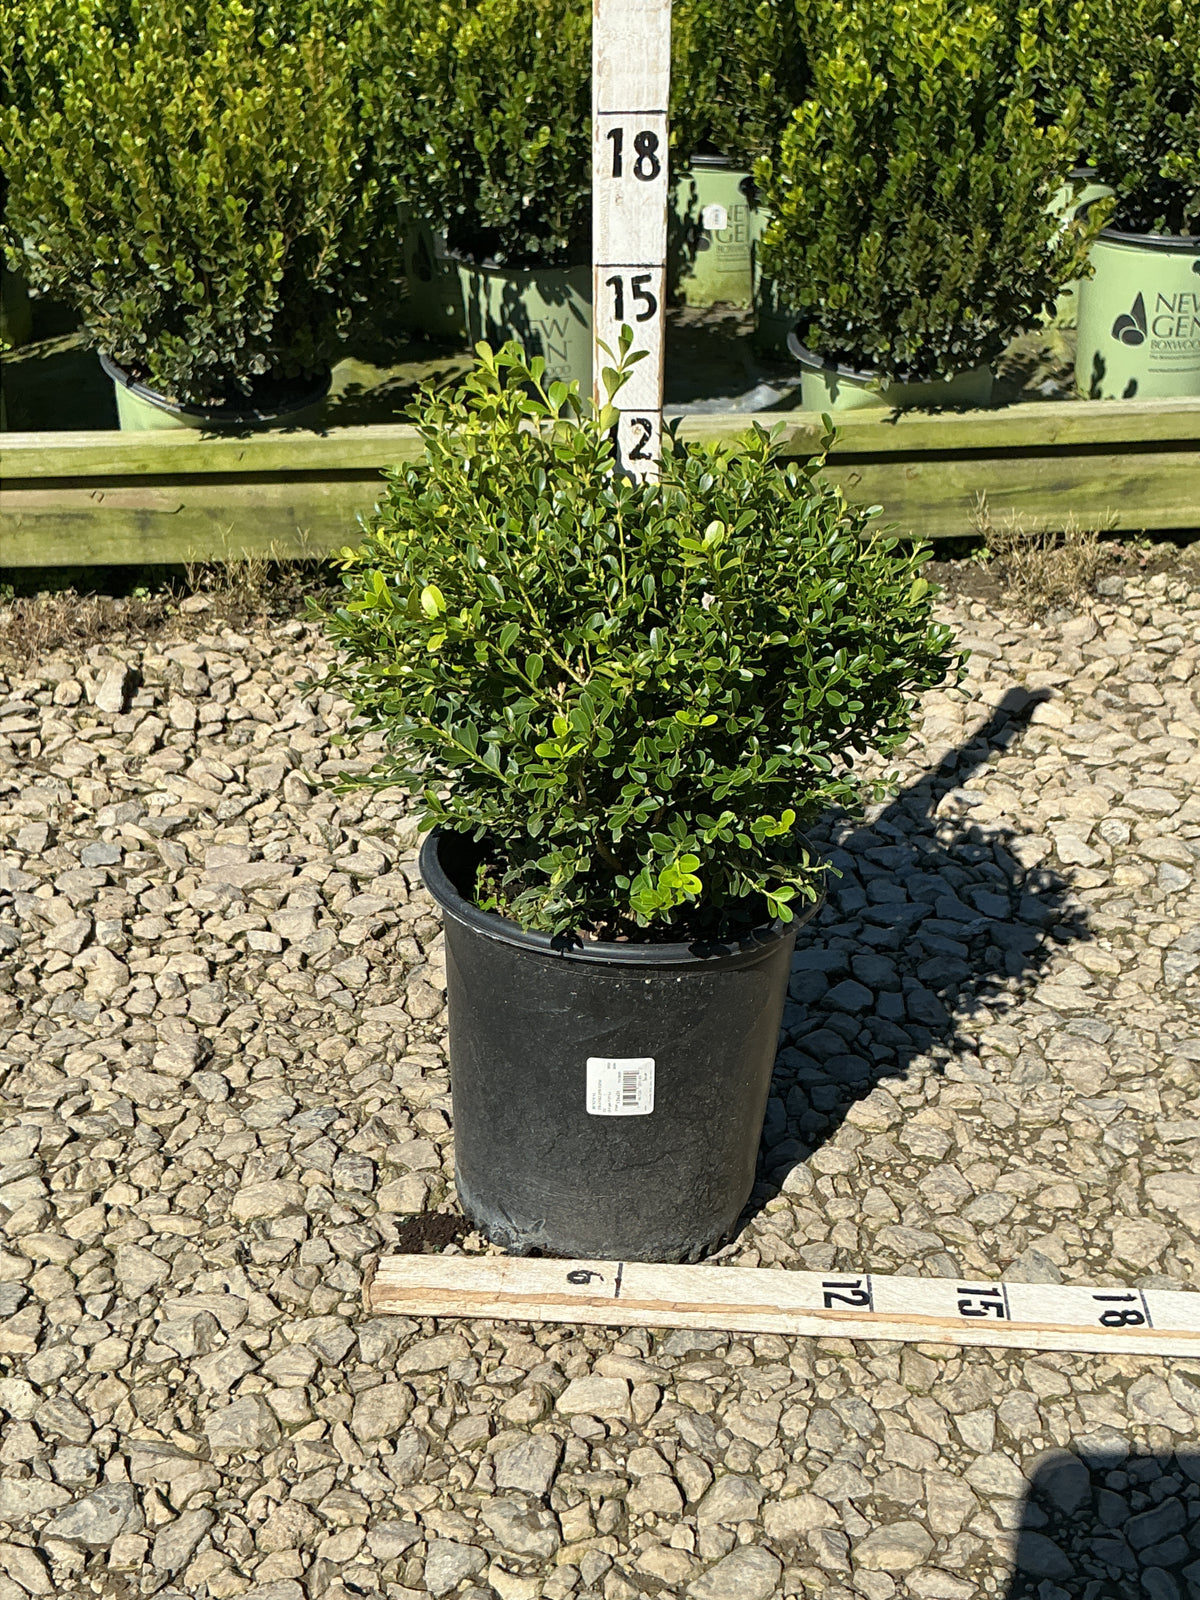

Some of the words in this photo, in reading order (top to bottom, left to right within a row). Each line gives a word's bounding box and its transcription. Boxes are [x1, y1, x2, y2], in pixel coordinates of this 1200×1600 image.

[606, 127, 661, 182] 18
[605, 272, 657, 322] 15
[822, 1279, 870, 1309] 12
[957, 1287, 1004, 1319] 15
[1092, 1292, 1146, 1328] 18
